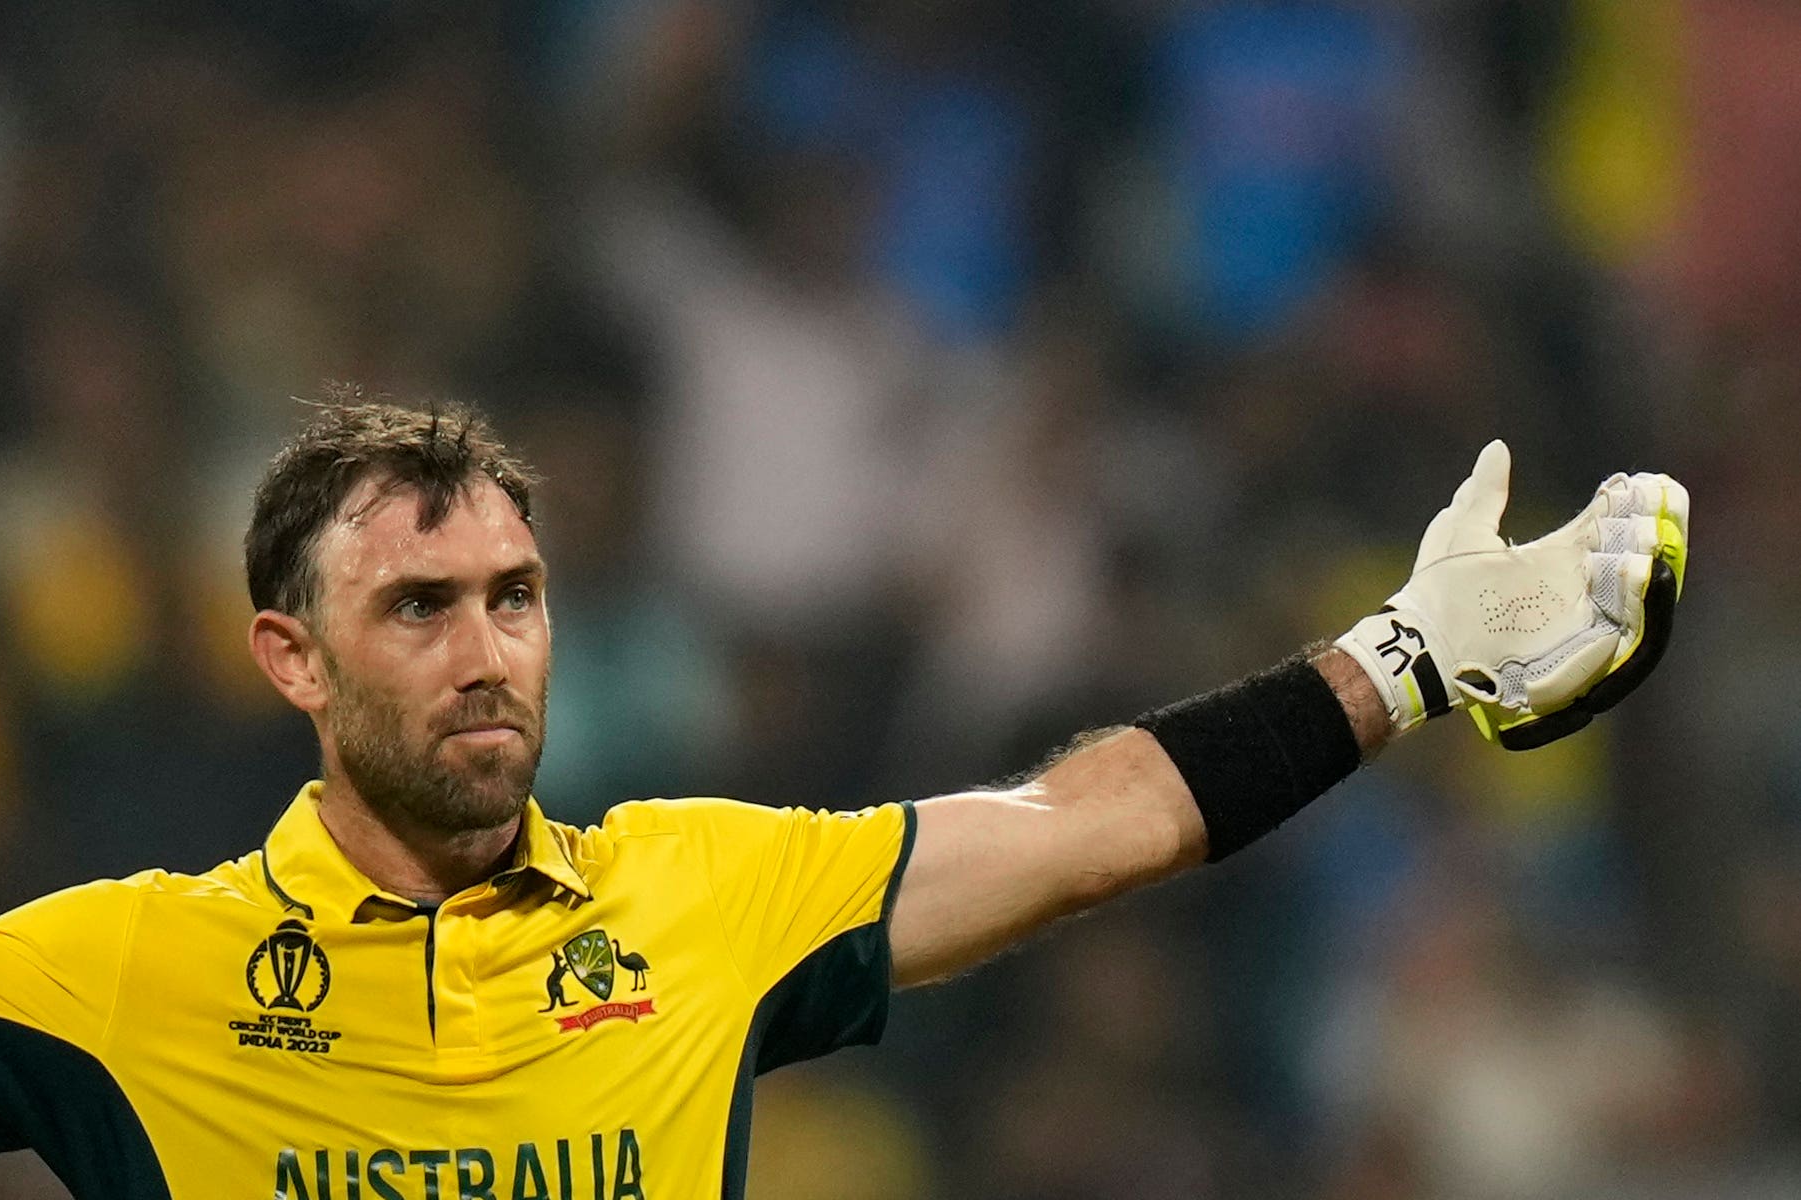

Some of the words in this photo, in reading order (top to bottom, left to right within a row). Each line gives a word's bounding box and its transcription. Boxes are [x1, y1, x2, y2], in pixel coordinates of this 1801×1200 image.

[229, 1020, 273, 1033] CRICKET
[277, 1026, 316, 1039] WORLD
[318, 1030, 342, 1040] CUP
[239, 1033, 283, 1050] INDIA
[286, 1039, 330, 1053] 2023
